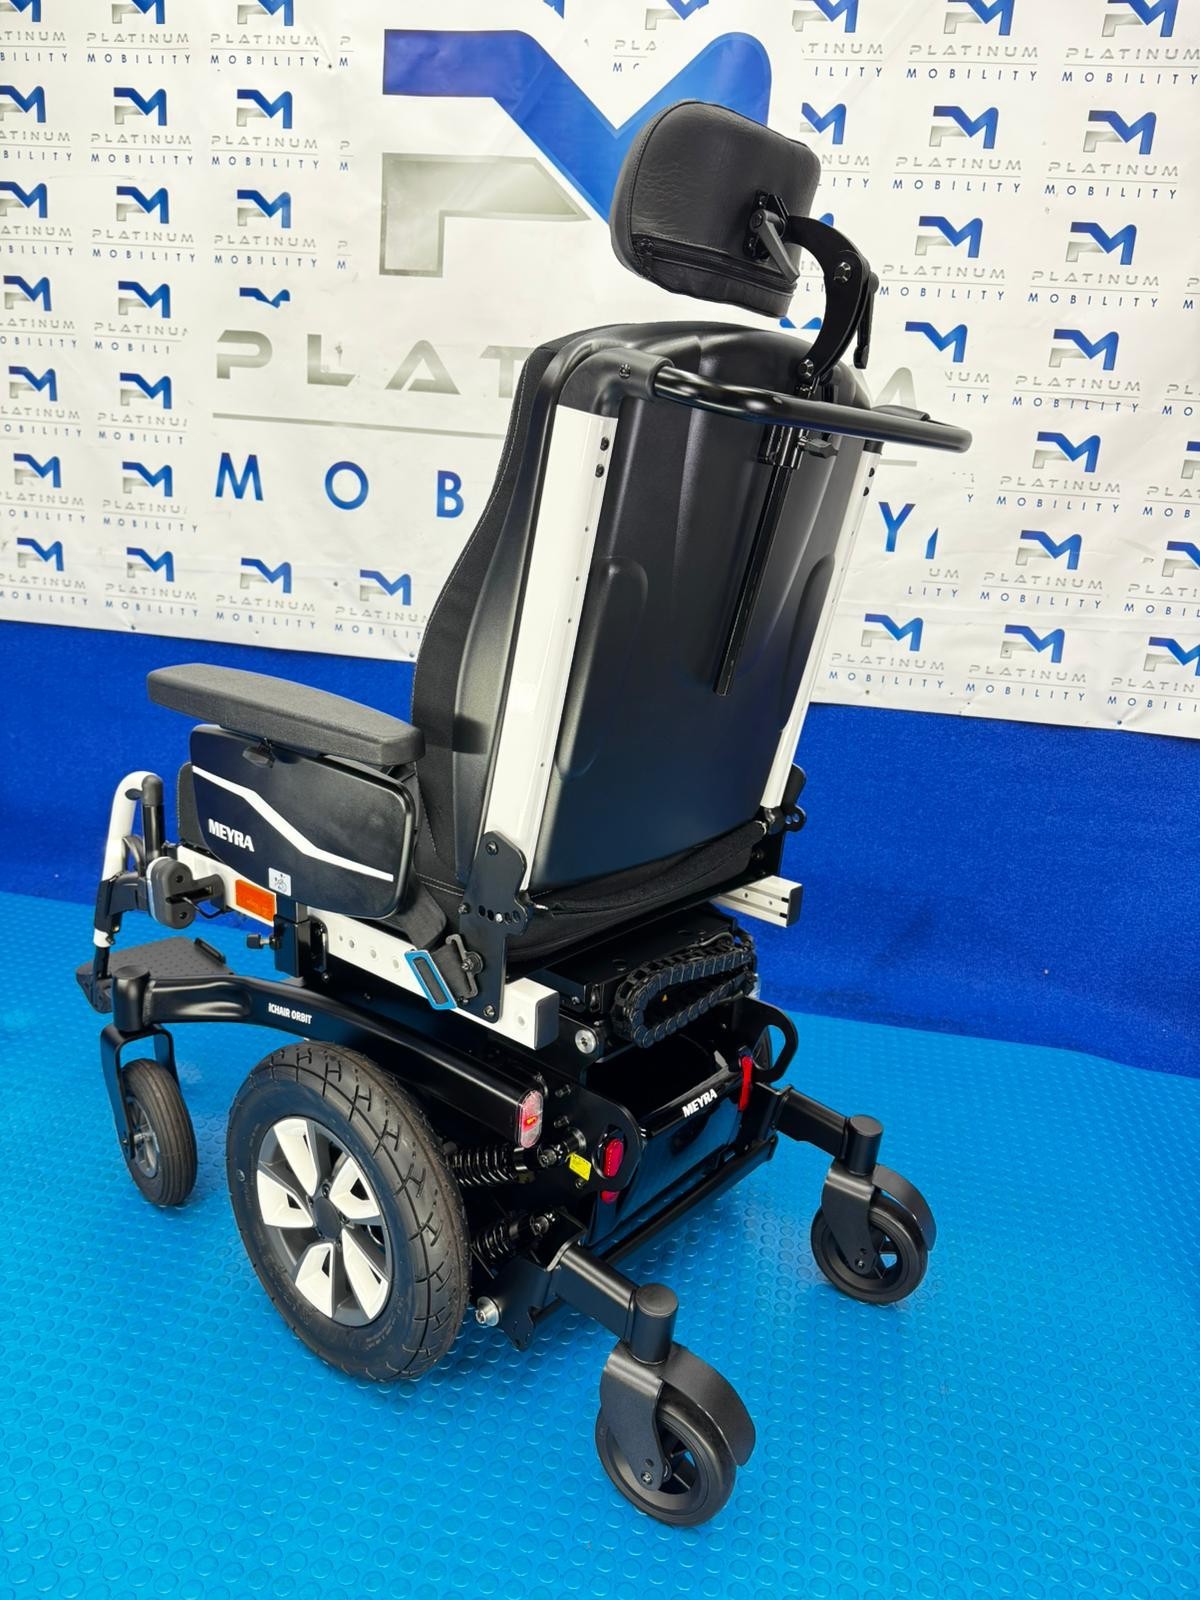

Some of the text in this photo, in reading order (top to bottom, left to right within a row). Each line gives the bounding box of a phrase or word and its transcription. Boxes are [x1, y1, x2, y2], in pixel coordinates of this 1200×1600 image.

[86, 32, 189, 44] PLATINUM
[210, 33, 319, 46] PLATINUM
[801, 41, 883, 54] TINUM
[909, 44, 1038, 58] PLATINUM
[1065, 47, 1200, 60] PLATINUM
[87, 53, 191, 64] MOBILITY
[210, 54, 319, 67] MOBILITY
[906, 68, 1037, 81] MOBILITY
[1061, 71, 1198, 85] MOBILITY
[90, 133, 192, 145] PLATINUM
[211, 135, 318, 149] PLATINUM
[91, 153, 193, 165] MOBILITY
[211, 156, 319, 169] MOBILITY
[896, 156, 1022, 171] PLATINUM
[1048, 161, 1178, 177] PLATINUM
[892, 179, 1021, 193] MOBILITY
[1044, 184, 1177, 199] MOBILITY
[92, 229, 194, 243] PLATINUM
[214, 234, 316, 248] PLATINUM
[92, 248, 195, 262] MOBILITY
[214, 254, 317, 268] MOBILITY
[882, 263, 1005, 279] PLATINUM
[1031, 270, 1159, 287] PLATINUM
[878, 285, 1004, 301] MOBILITY
[1028, 292, 1158, 308] MOBILITY
[1015, 375, 1141, 392] PLATINUM
[1012, 396, 1139, 413] MOBILITY
[1000, 475, 1120, 493] PLATINUM
[102, 499, 187, 515] PLATINU
[996, 496, 1120, 513] MOBILITY
[103, 517, 198, 533] MOBILITY
[984, 572, 1103, 590] PLATINUM
[105, 583, 197, 600] PLATINUM
[215, 594, 316, 612] PLATINUM
[980, 591, 1102, 609] MOBILITY
[105, 600, 198, 617] MOBILITY
[216, 611, 316, 632] MOBILITY
[831, 652, 945, 671] PLATINUM
[828, 671, 944, 689] MOBILITY
[969, 664, 1086, 683] PLATINUM
[965, 682, 1085, 704] MOBILITY
[207, 818, 255, 853] MEYRA
[267, 1002, 313, 1025] ICHAIR ORBIT
[681, 1087, 719, 1119] MEYRA
